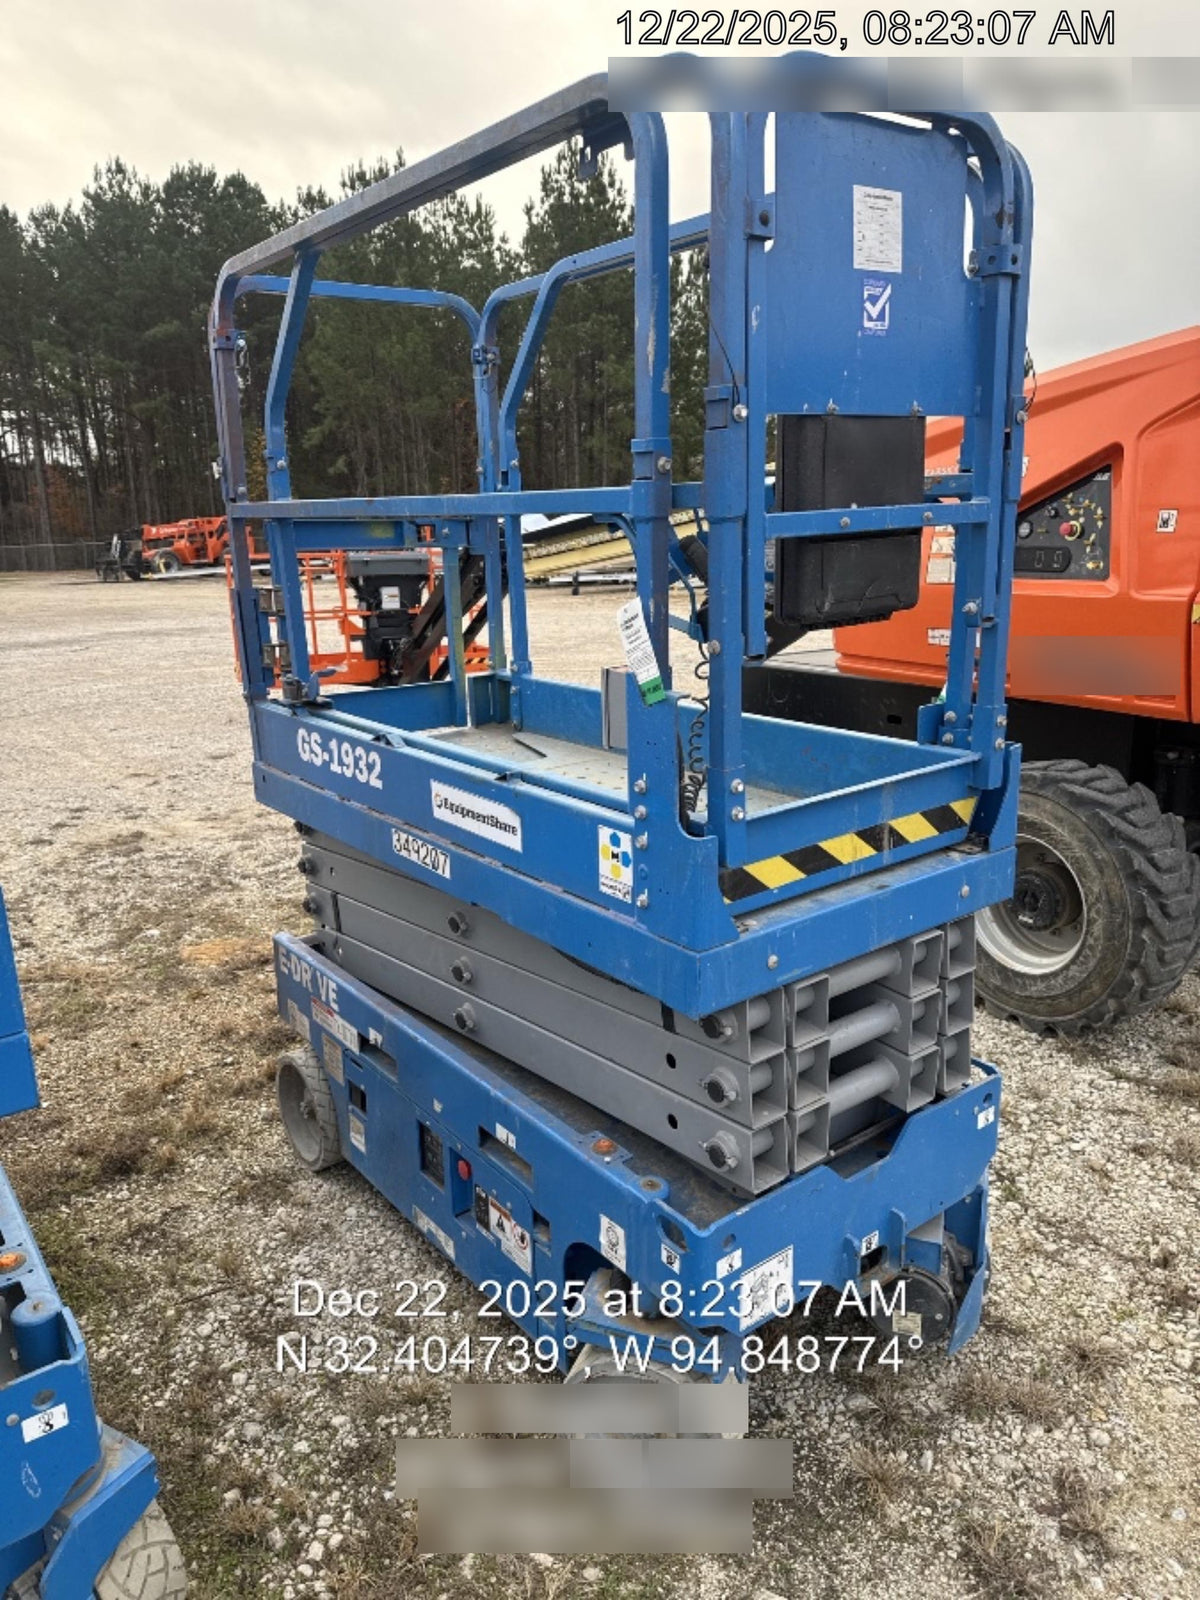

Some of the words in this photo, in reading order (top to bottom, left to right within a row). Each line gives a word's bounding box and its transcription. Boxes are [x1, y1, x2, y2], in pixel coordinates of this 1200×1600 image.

[297, 728, 383, 790] GS-1932
[443, 797, 518, 836] EquipmentShare
[393, 829, 449, 877] 349207
[279, 946, 339, 1012] E-DRVE
